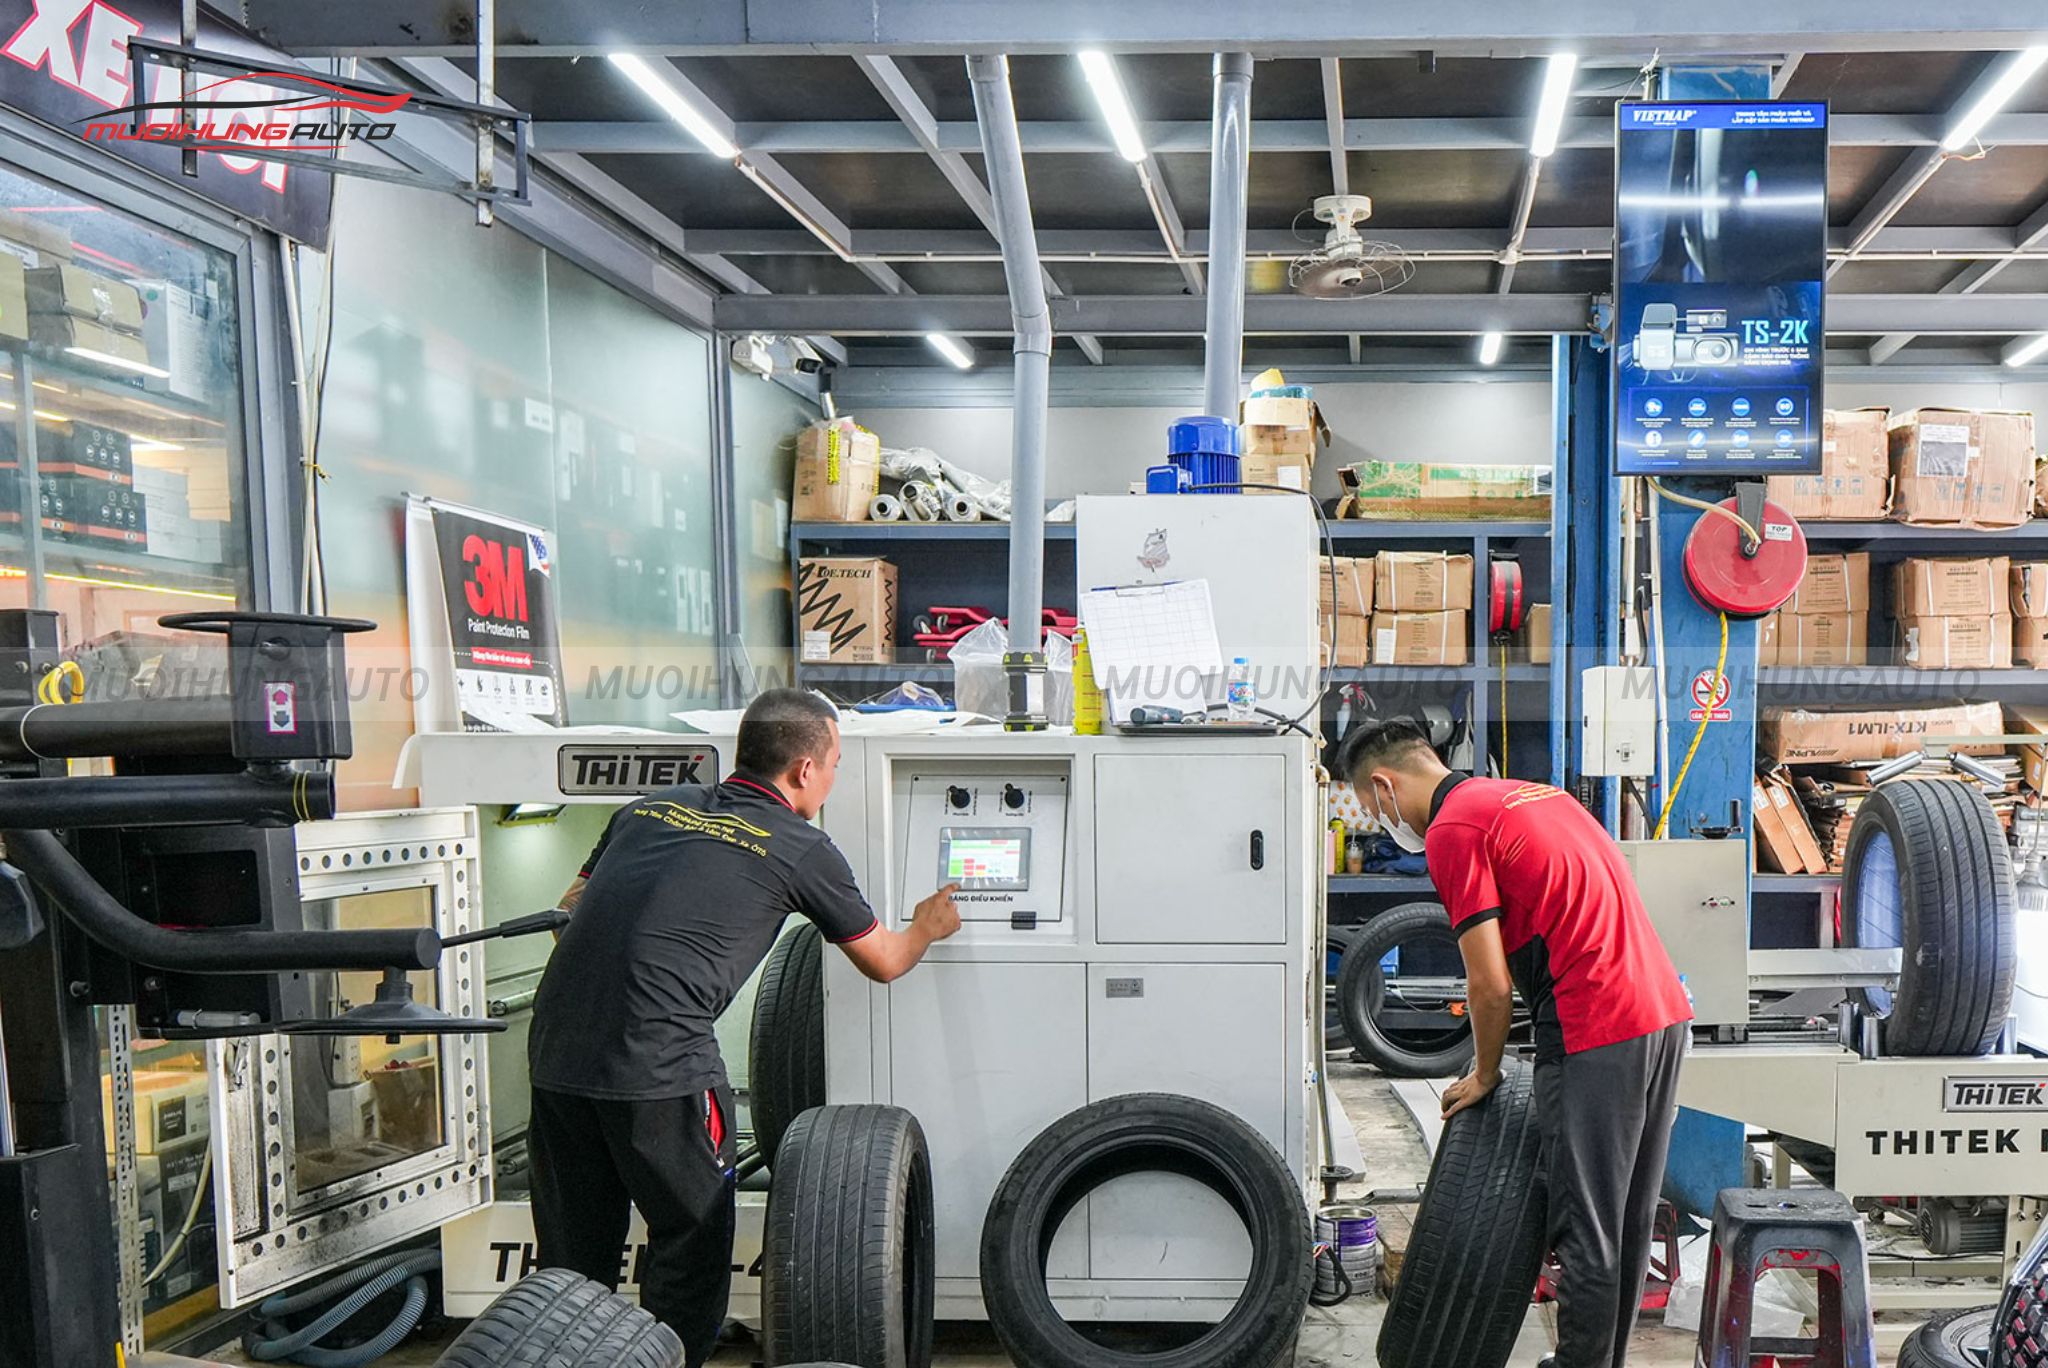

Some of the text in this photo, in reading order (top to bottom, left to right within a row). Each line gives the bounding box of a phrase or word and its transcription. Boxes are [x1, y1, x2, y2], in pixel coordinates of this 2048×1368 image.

[0, 0, 144, 110] XE
[1633, 110, 1693, 121] VIETMAP
[1741, 320, 1809, 344] TS-2K
[463, 534, 529, 622] 3M
[468, 618, 530, 640] Paint Protection Film
[1865, 1129, 2020, 1155] THITEK
